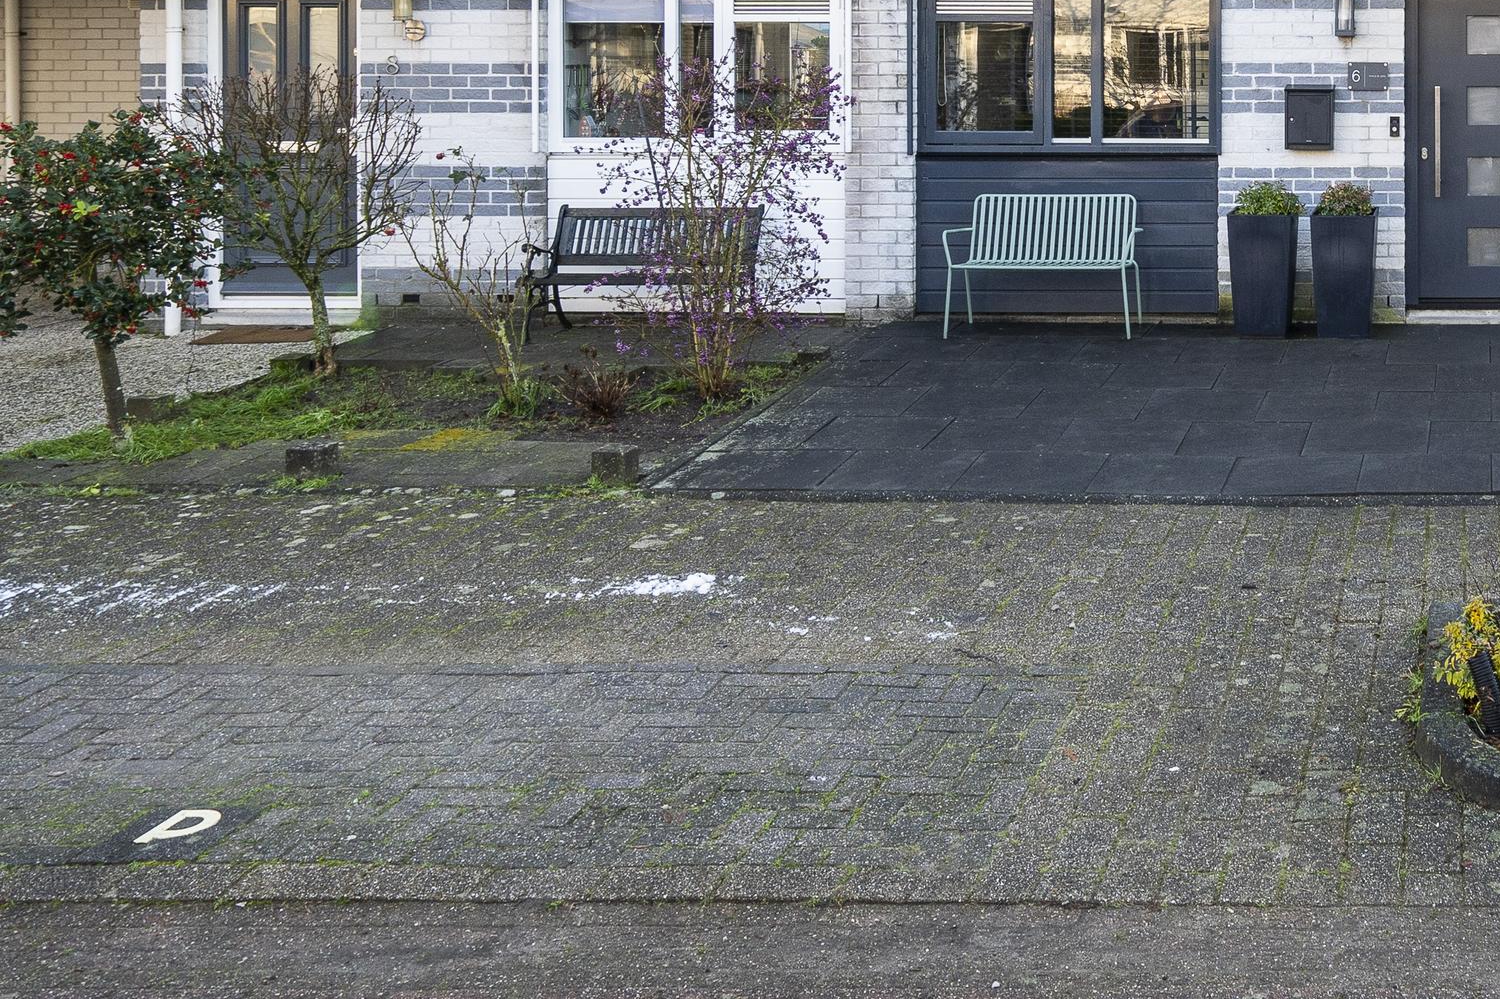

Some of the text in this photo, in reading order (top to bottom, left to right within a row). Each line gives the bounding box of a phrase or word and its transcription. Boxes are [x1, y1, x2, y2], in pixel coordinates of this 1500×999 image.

[386, 55, 400, 75] 8
[1351, 69, 1361, 83] 6
[132, 808, 222, 844] P
